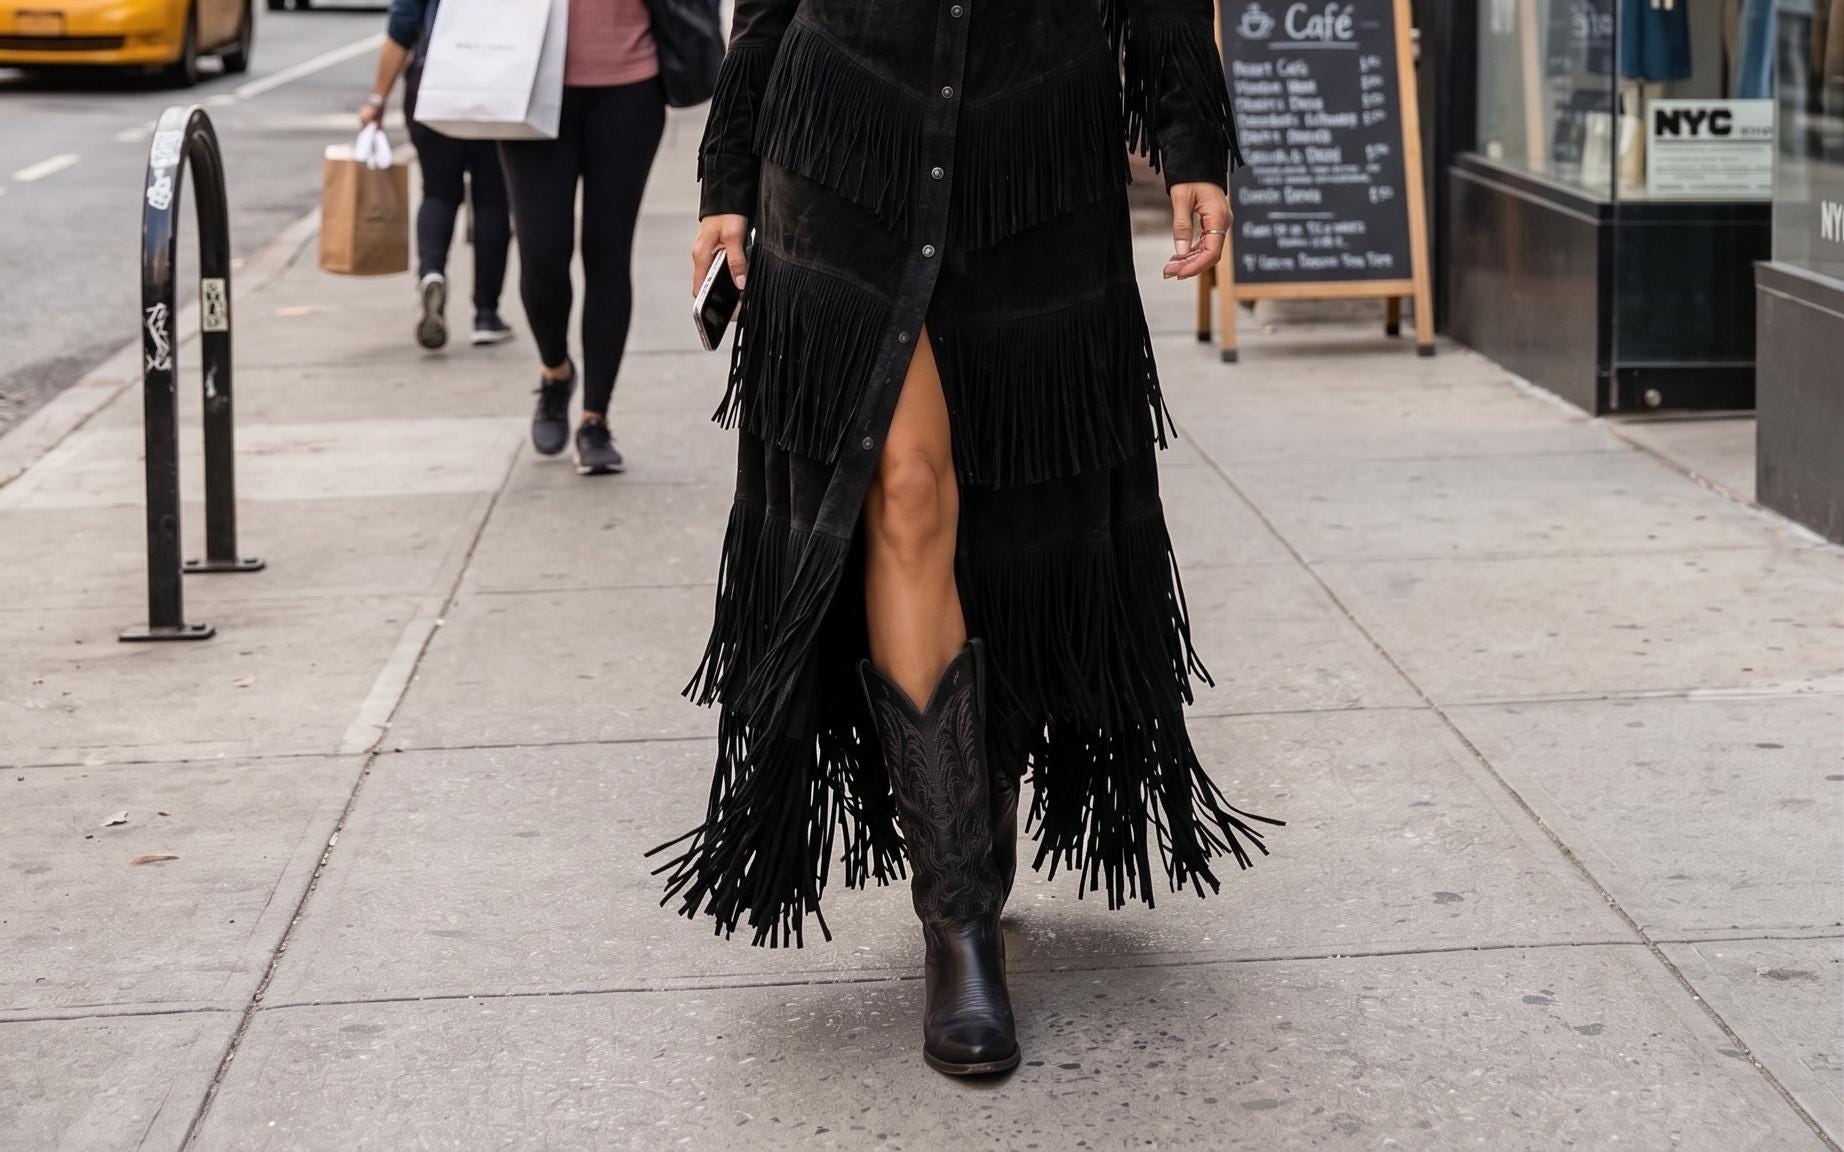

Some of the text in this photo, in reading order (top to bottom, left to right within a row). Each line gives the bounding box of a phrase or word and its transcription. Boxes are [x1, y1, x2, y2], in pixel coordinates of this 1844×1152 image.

[1285, 2, 1354, 42] Café
[1655, 109, 1732, 136] NYC
[1821, 200, 1844, 244] NY
